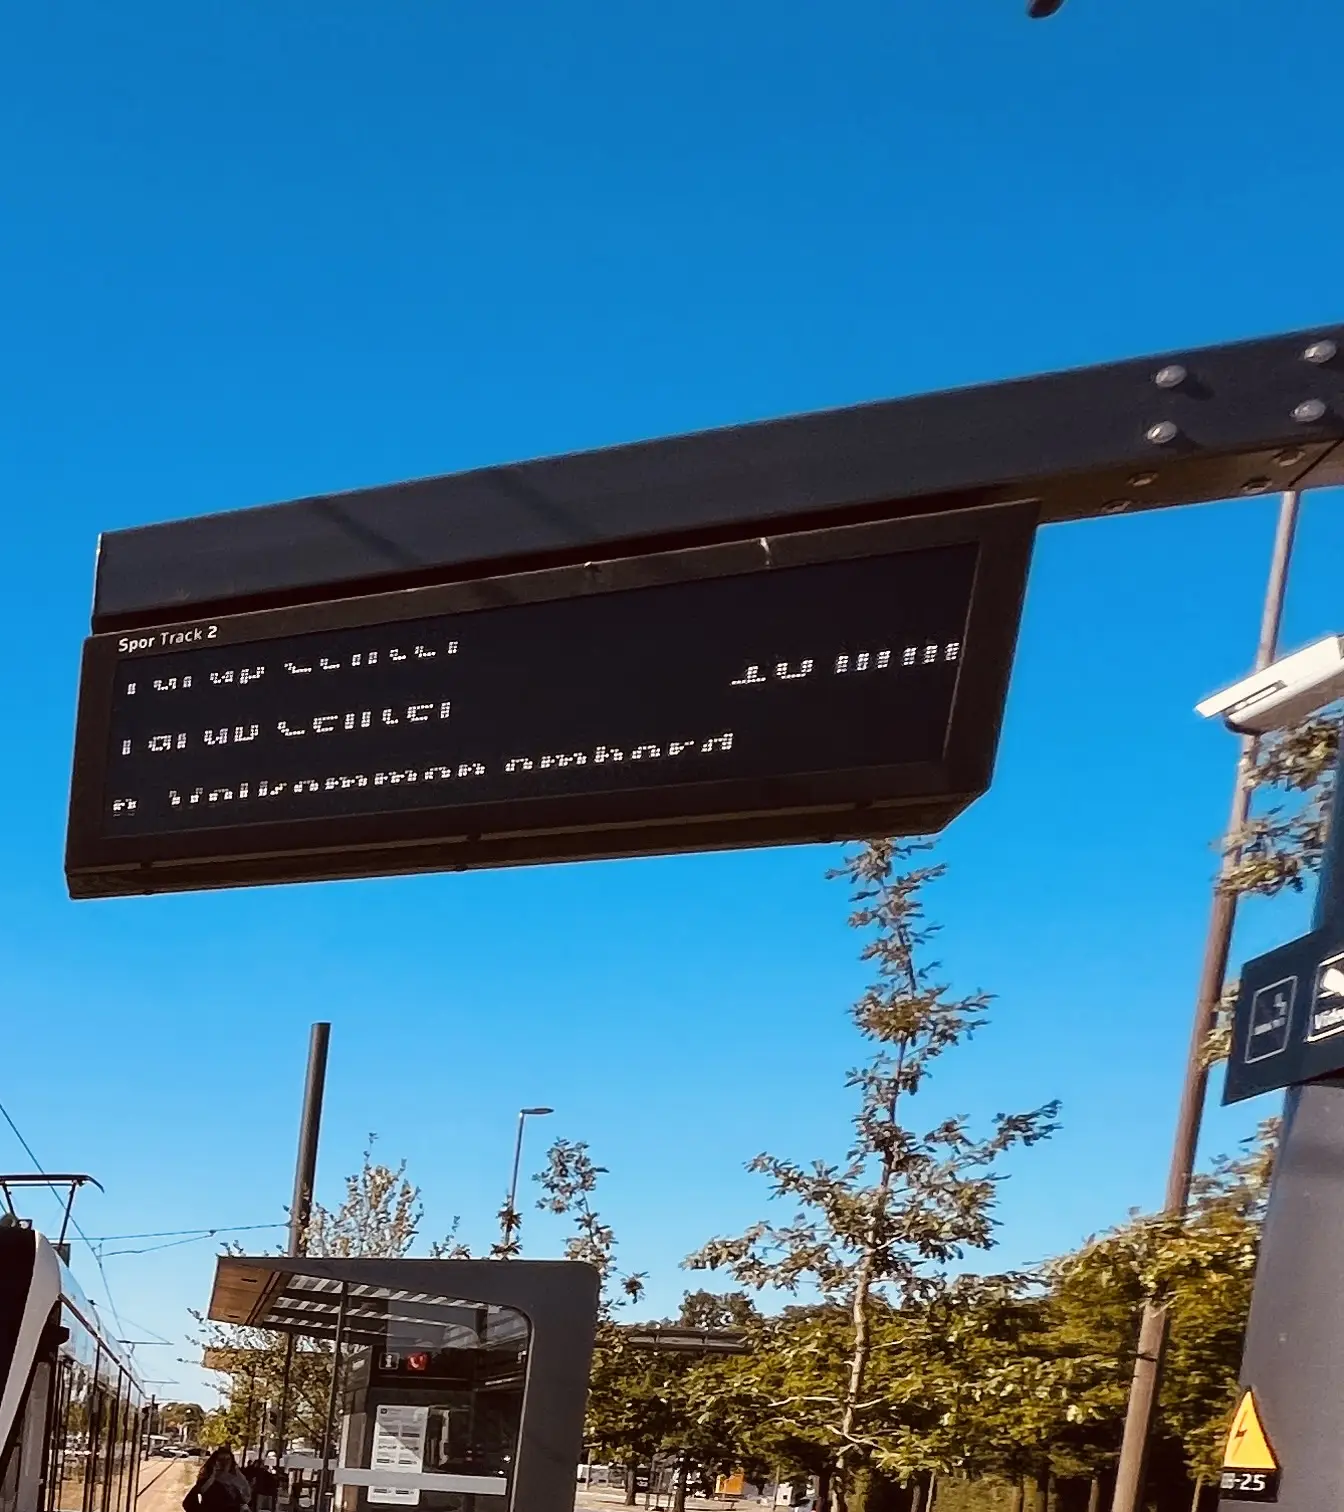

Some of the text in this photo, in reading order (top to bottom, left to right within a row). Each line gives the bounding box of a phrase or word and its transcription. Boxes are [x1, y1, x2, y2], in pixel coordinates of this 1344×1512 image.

[118, 625, 218, 653] Spor Track 2
